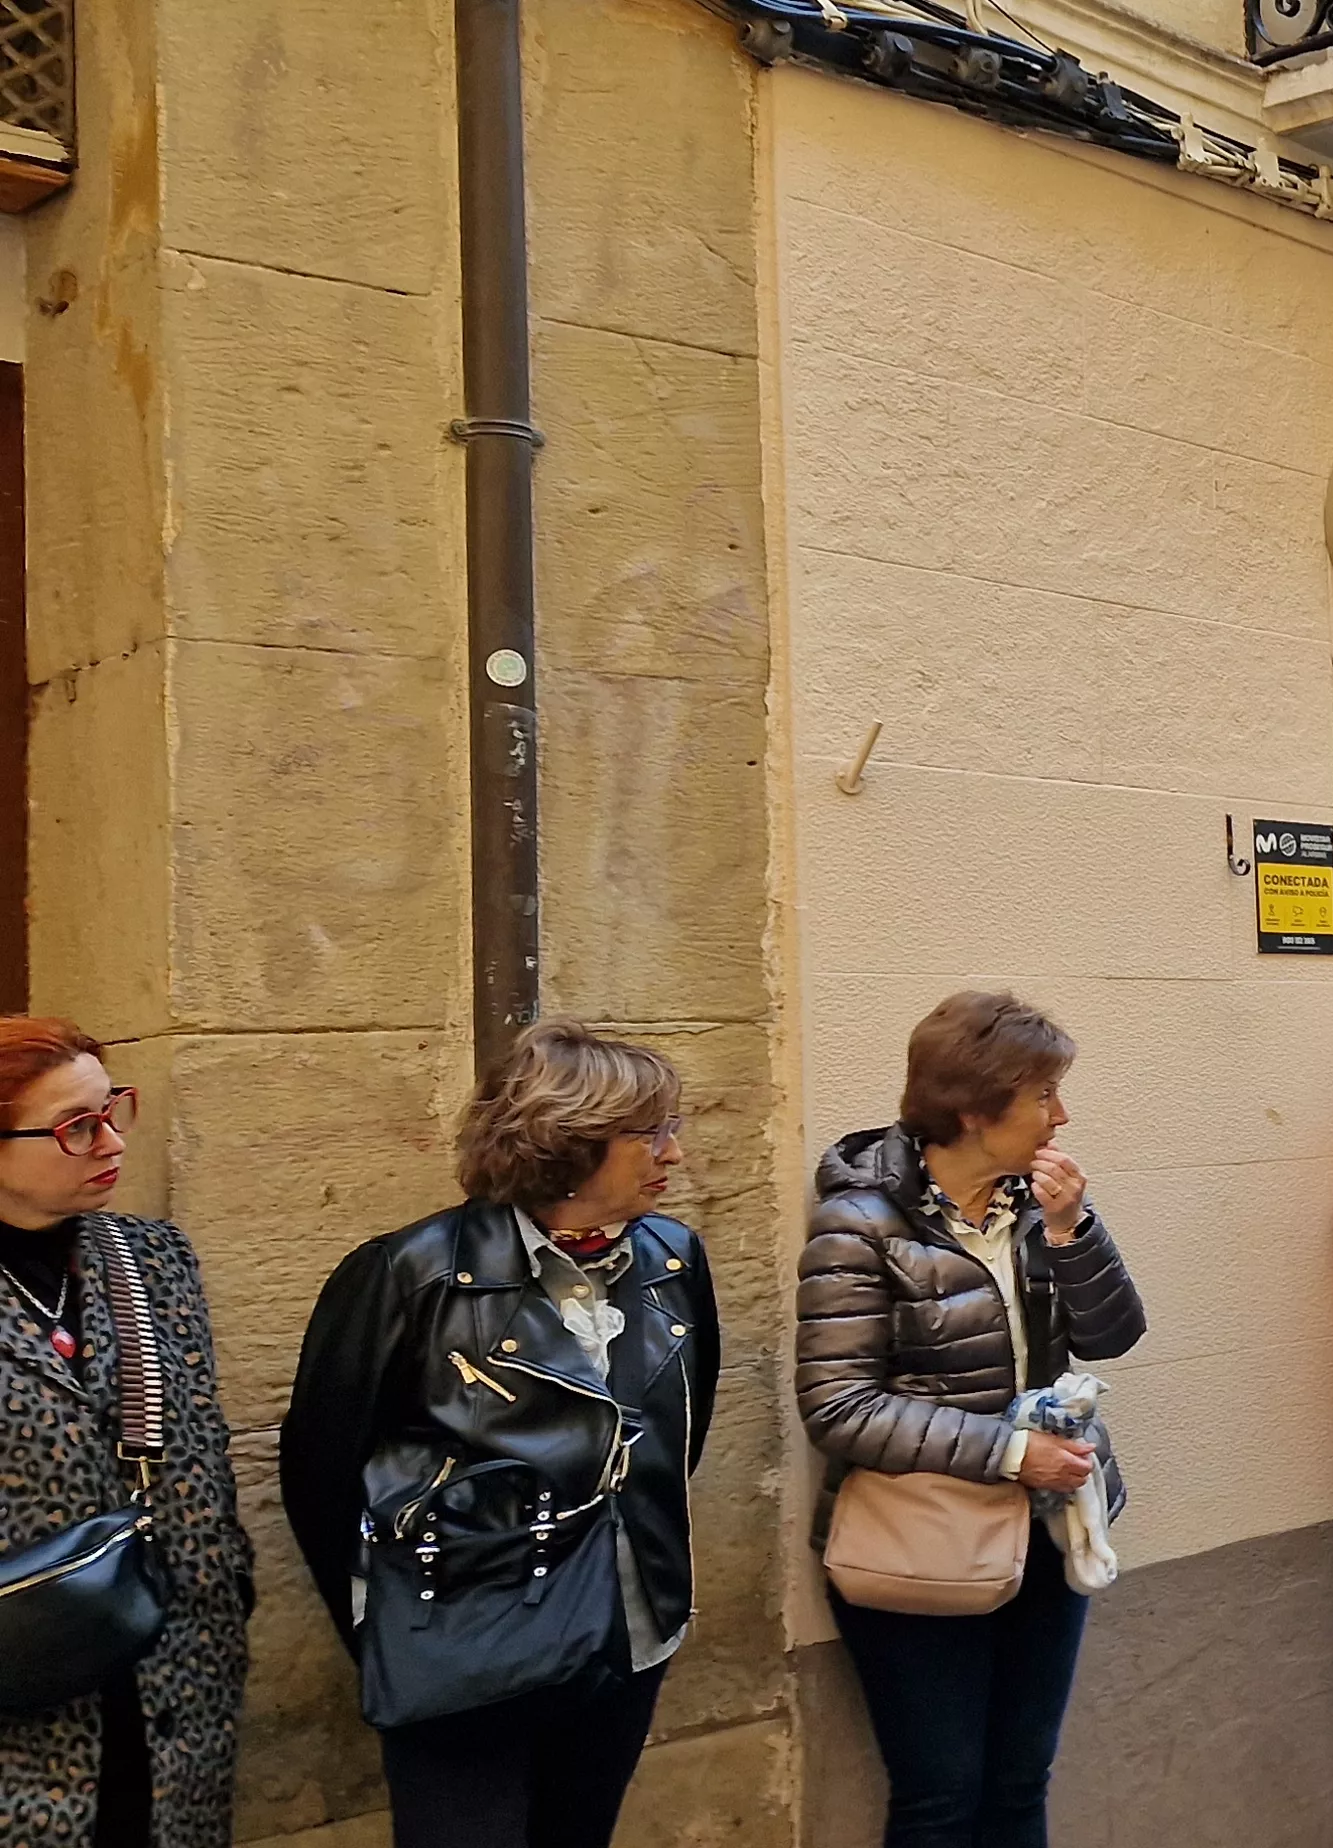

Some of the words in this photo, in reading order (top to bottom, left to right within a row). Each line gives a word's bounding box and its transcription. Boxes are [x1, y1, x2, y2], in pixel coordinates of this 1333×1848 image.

[1264, 874, 1329, 888] CONECTADA
[1264, 887, 1278, 895] CON
[1280, 888, 1299, 896] AVISO
